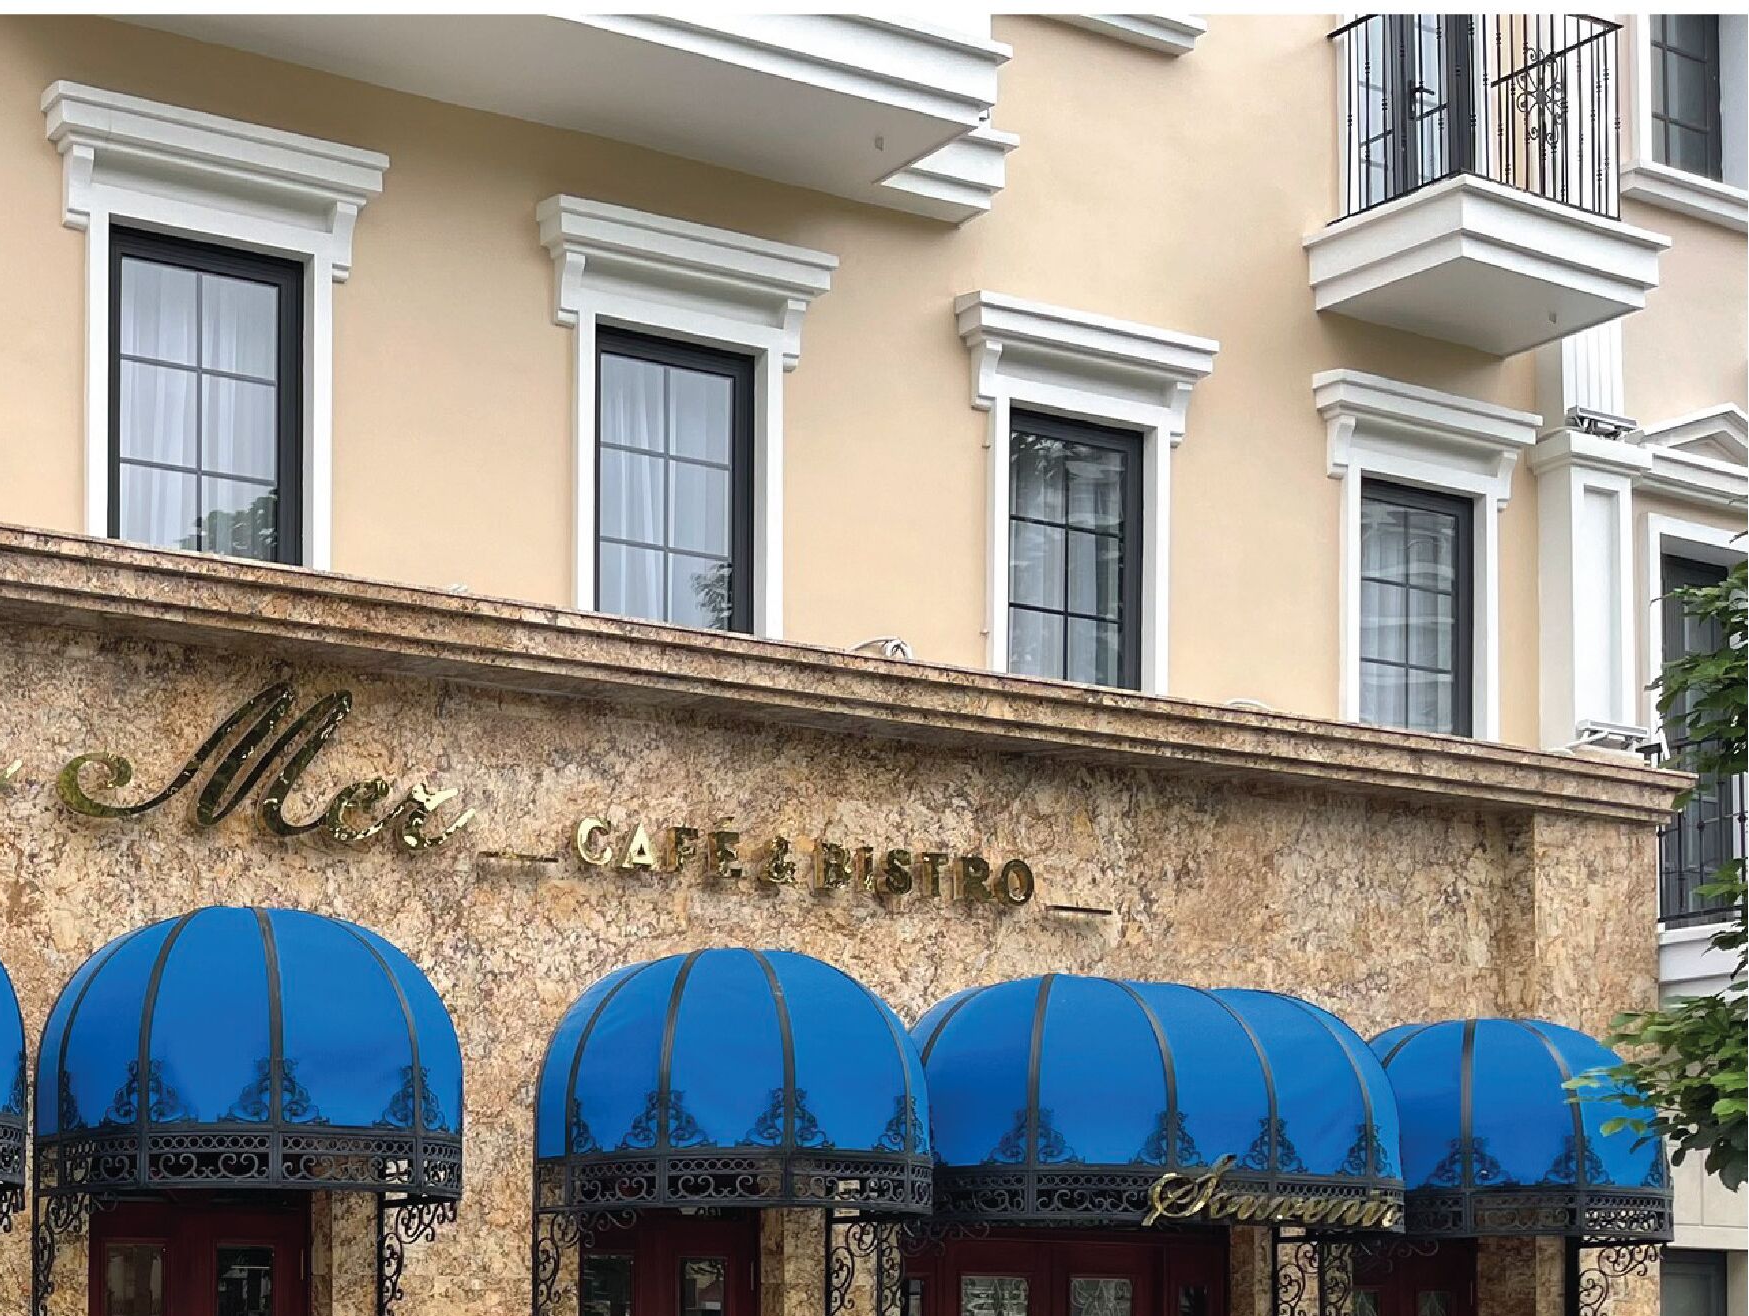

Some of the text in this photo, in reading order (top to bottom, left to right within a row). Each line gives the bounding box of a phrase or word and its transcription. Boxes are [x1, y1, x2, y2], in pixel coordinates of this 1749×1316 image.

[57, 680, 477, 852] Mer
[571, 815, 1036, 906] CAFÉ & BISTRO
[1141, 1153, 1403, 1227] Souvenir
